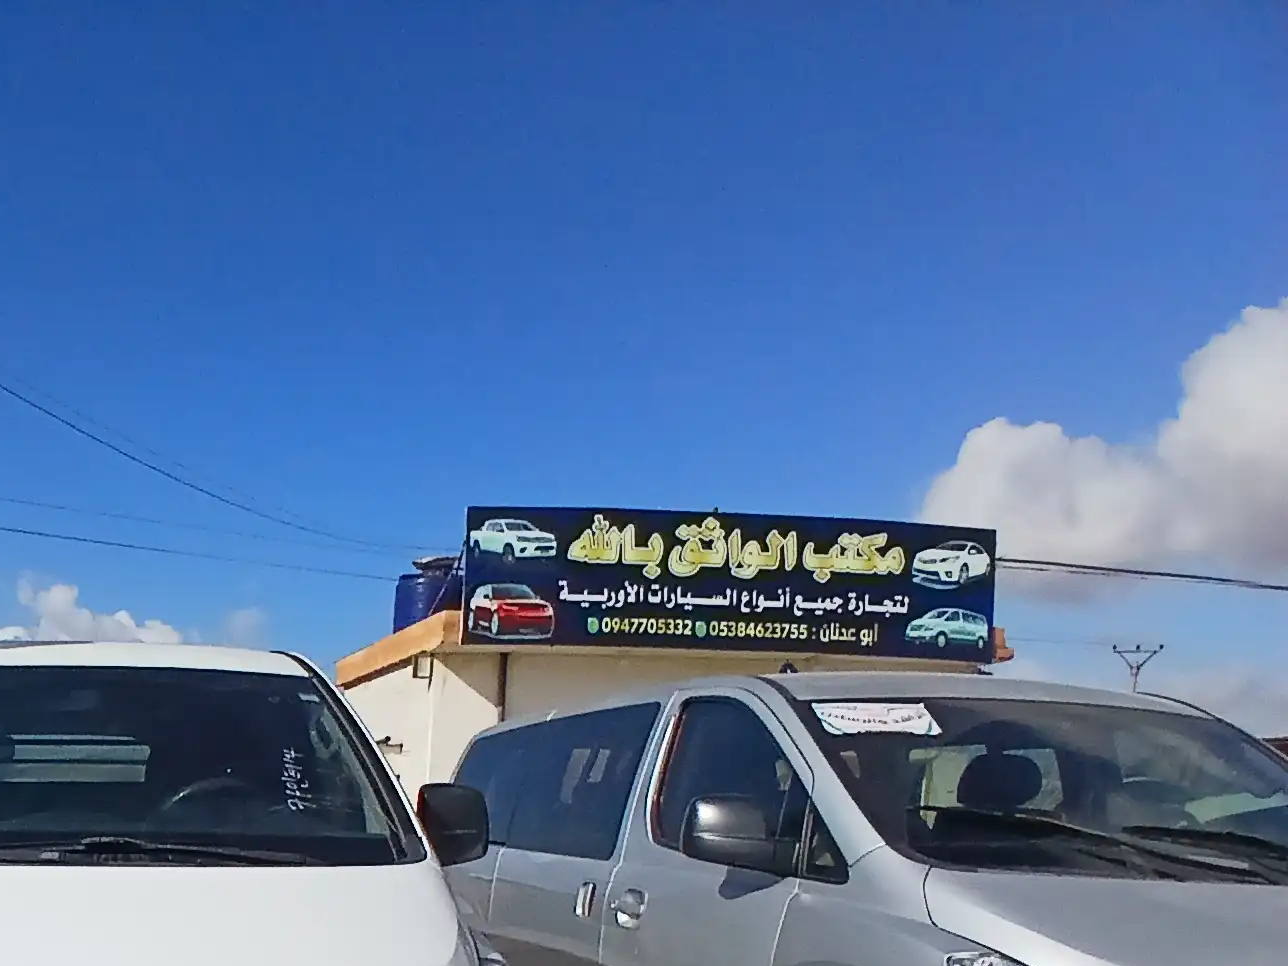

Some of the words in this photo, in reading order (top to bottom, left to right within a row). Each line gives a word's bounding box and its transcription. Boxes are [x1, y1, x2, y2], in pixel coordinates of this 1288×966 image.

[567, 514, 664, 579] بالله
[668, 517, 797, 579] الواثق
[803, 532, 905, 583] مكتب
[558, 580, 644, 609] الأوربية
[648, 584, 737, 611] السيارات
[741, 586, 790, 613] أنواع
[794, 594, 844, 616] جميع
[847, 592, 909, 617] لتجارة
[602, 617, 692, 635] 0947705332
[709, 620, 808, 640] 05384623755
[820, 622, 856, 643] عدنان
